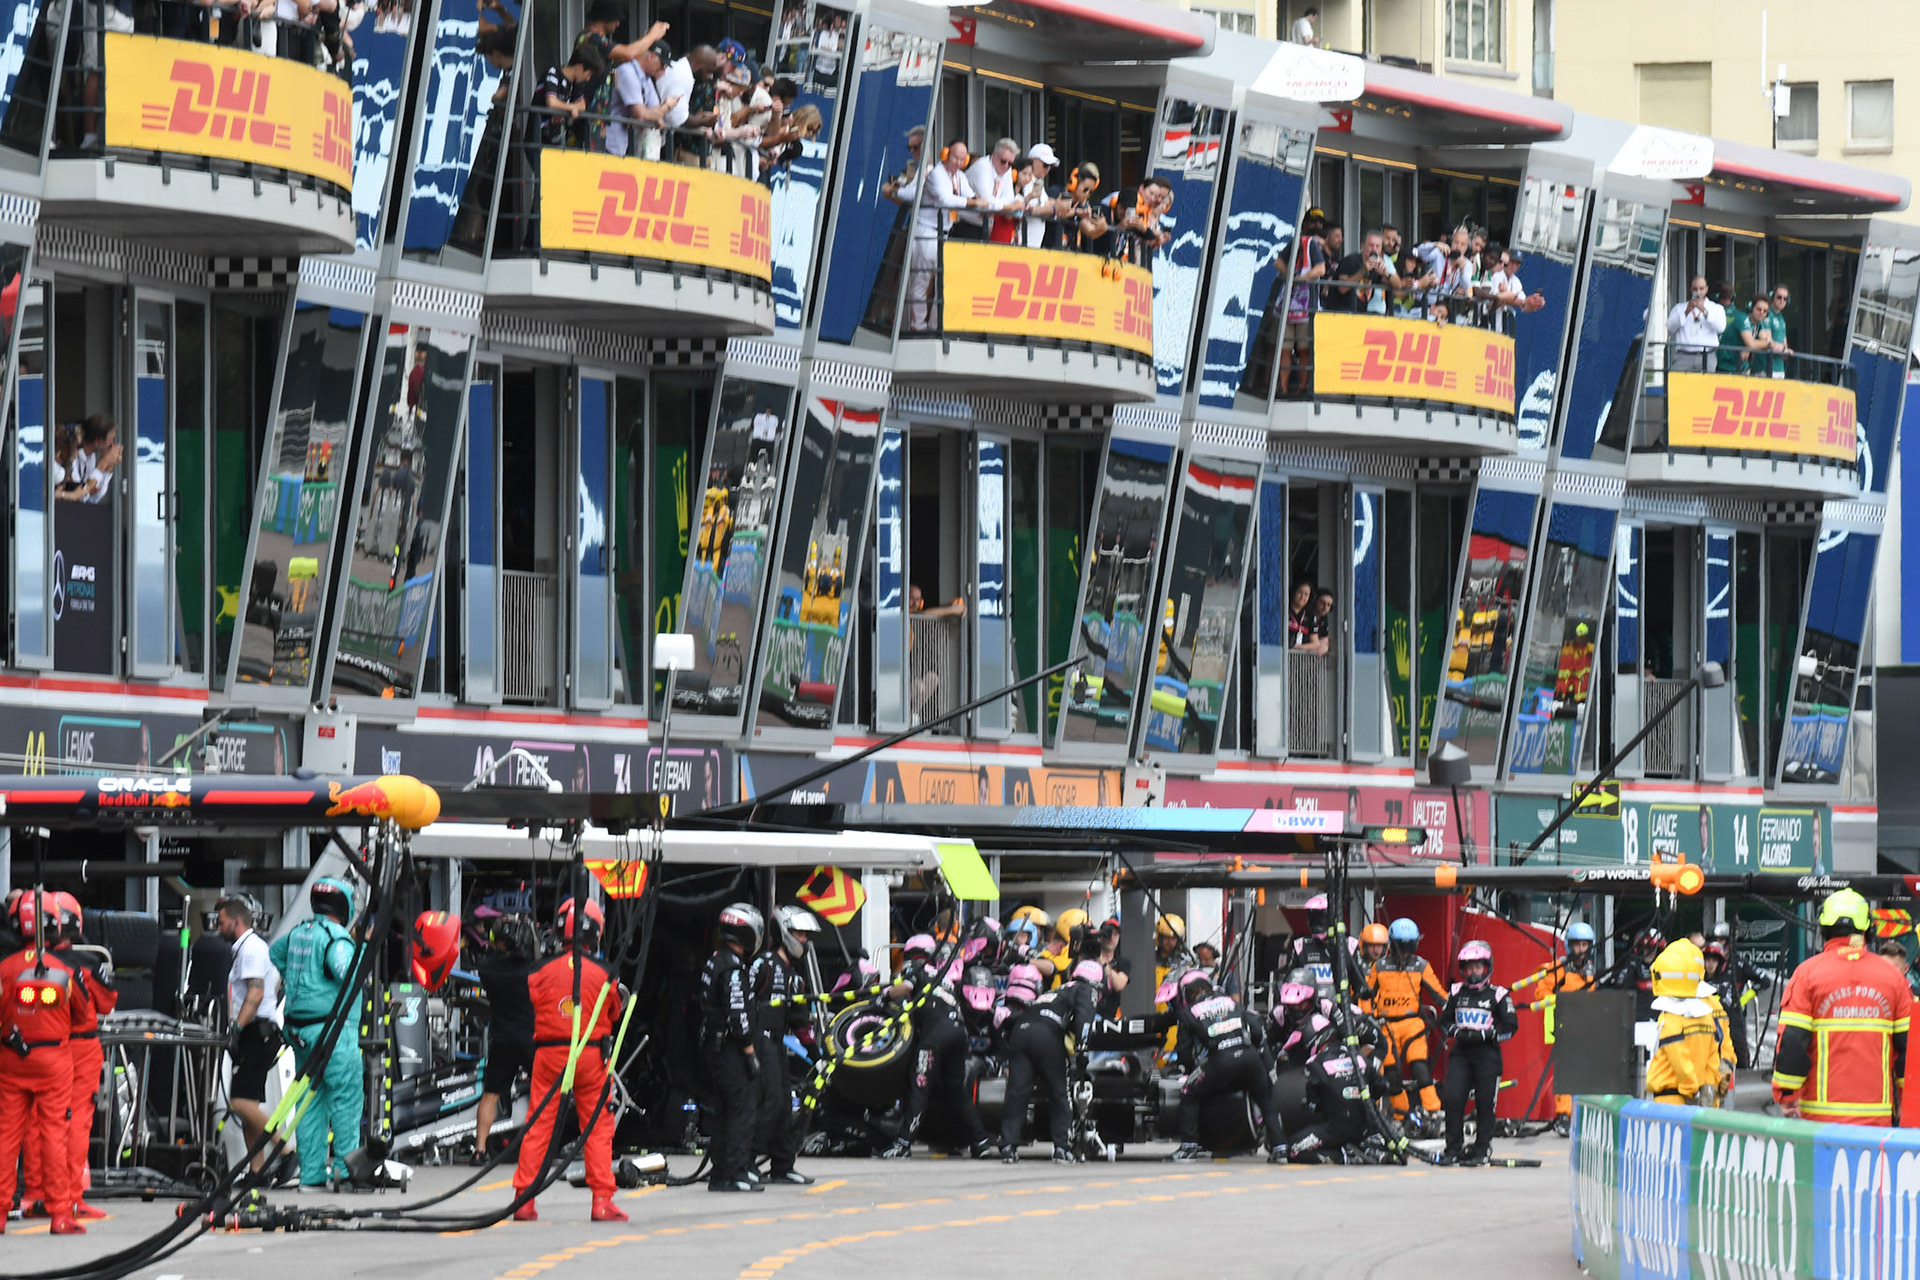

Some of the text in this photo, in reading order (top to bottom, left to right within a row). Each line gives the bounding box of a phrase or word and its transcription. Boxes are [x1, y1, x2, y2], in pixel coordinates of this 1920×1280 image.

[168, 58, 276, 147] DHL
[596, 170, 695, 246] DHL
[993, 260, 1083, 324] DHL
[1360, 329, 1445, 387] DHL
[1711, 387, 1789, 439] DHL
[1826, 397, 1854, 450] DHL
[65, 730, 95, 765] LEWIS
[216, 736, 247, 772] EORGE
[98, 777, 192, 792] ORACLE
[652, 760, 693, 792] ETEBAN
[98, 792, 150, 807] Red Bull
[925, 779, 956, 805] LANDO
[1051, 784, 1077, 806] OSCAR
[1288, 816, 1326, 827] BWT
[1651, 813, 1678, 838] LANCE
[1760, 817, 1802, 842] FERNANDO
[1621, 807, 1638, 866] 18
[1733, 813, 1749, 866] 14
[1760, 842, 1792, 866] ALONSO
[1588, 869, 1651, 881] DP WORLD
[1797, 875, 1850, 892] Alfa Romeo
[1456, 1011, 1489, 1025] BWT
[1833, 1006, 1880, 1018] MONACO
